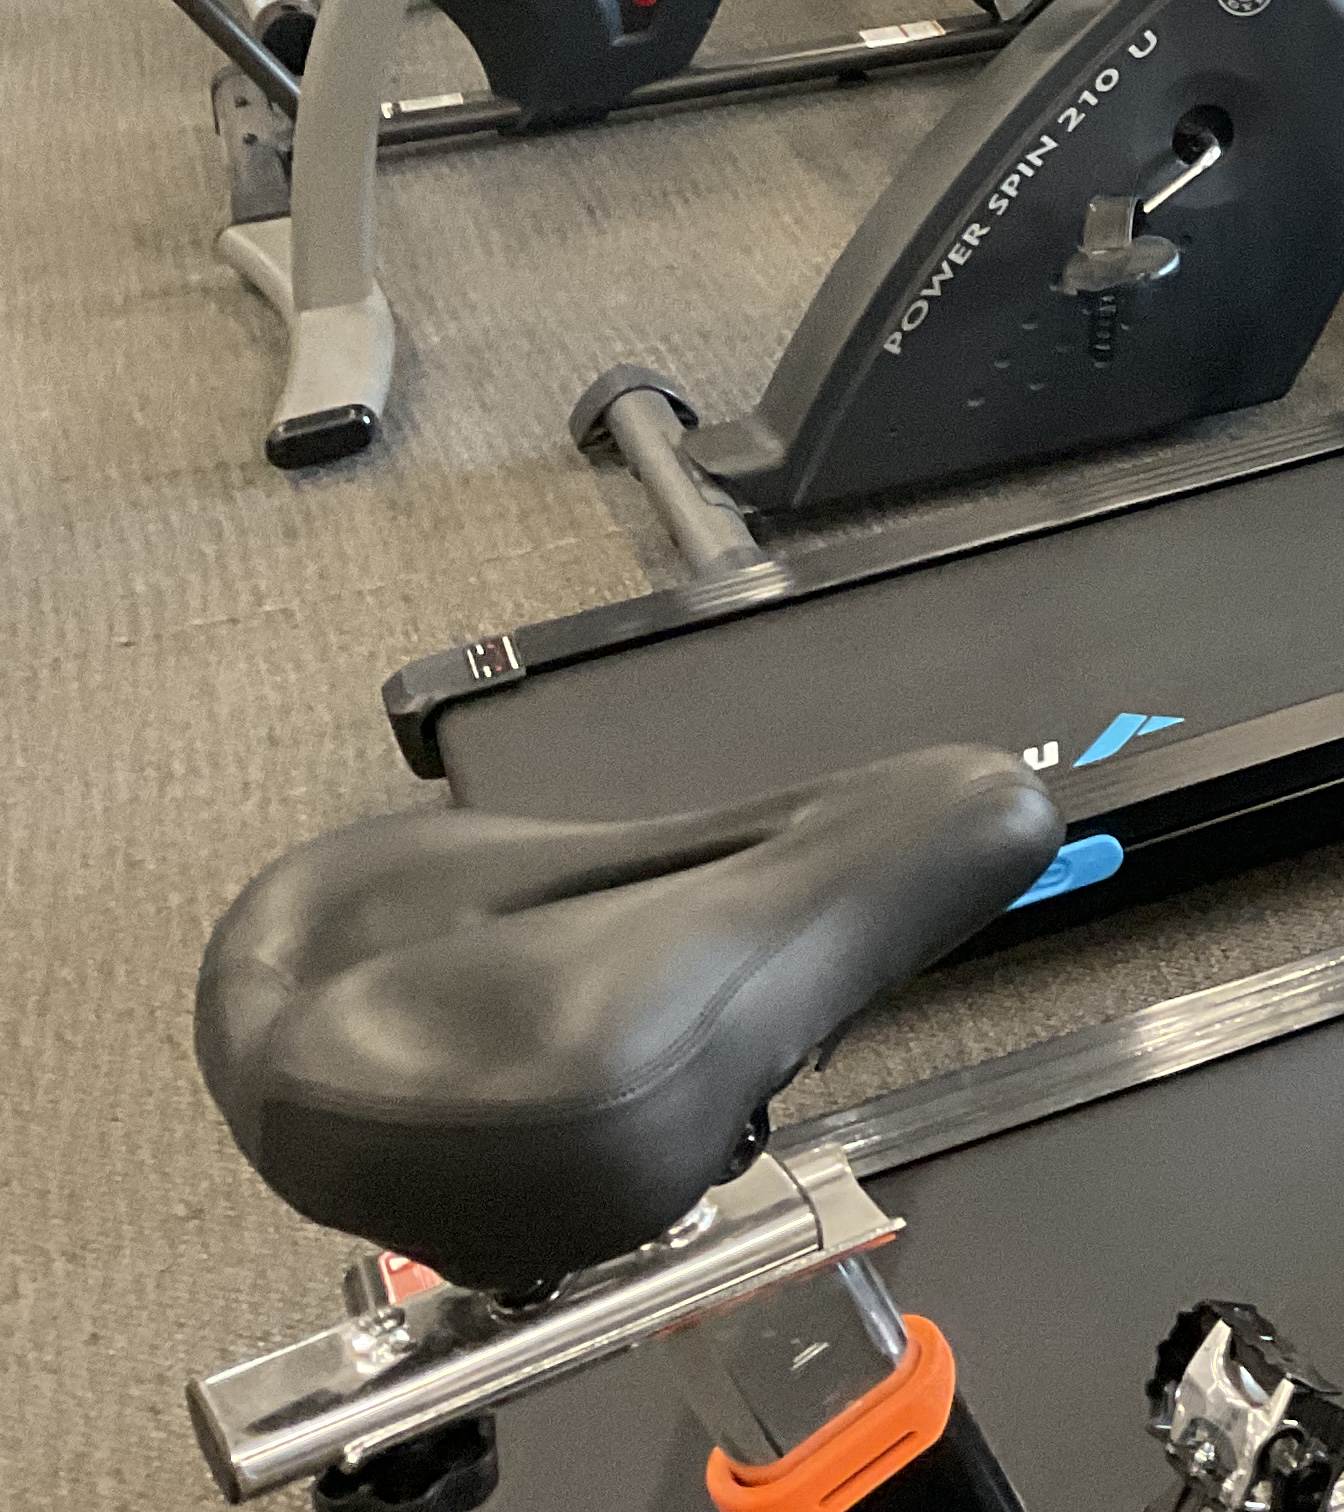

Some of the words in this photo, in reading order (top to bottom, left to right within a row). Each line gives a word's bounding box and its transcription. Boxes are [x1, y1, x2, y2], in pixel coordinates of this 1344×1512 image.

[883, 223, 990, 354] POWER
[988, 134, 1059, 216] SPIN
[1057, 68, 1120, 132] 210
[1128, 29, 1157, 58] U
